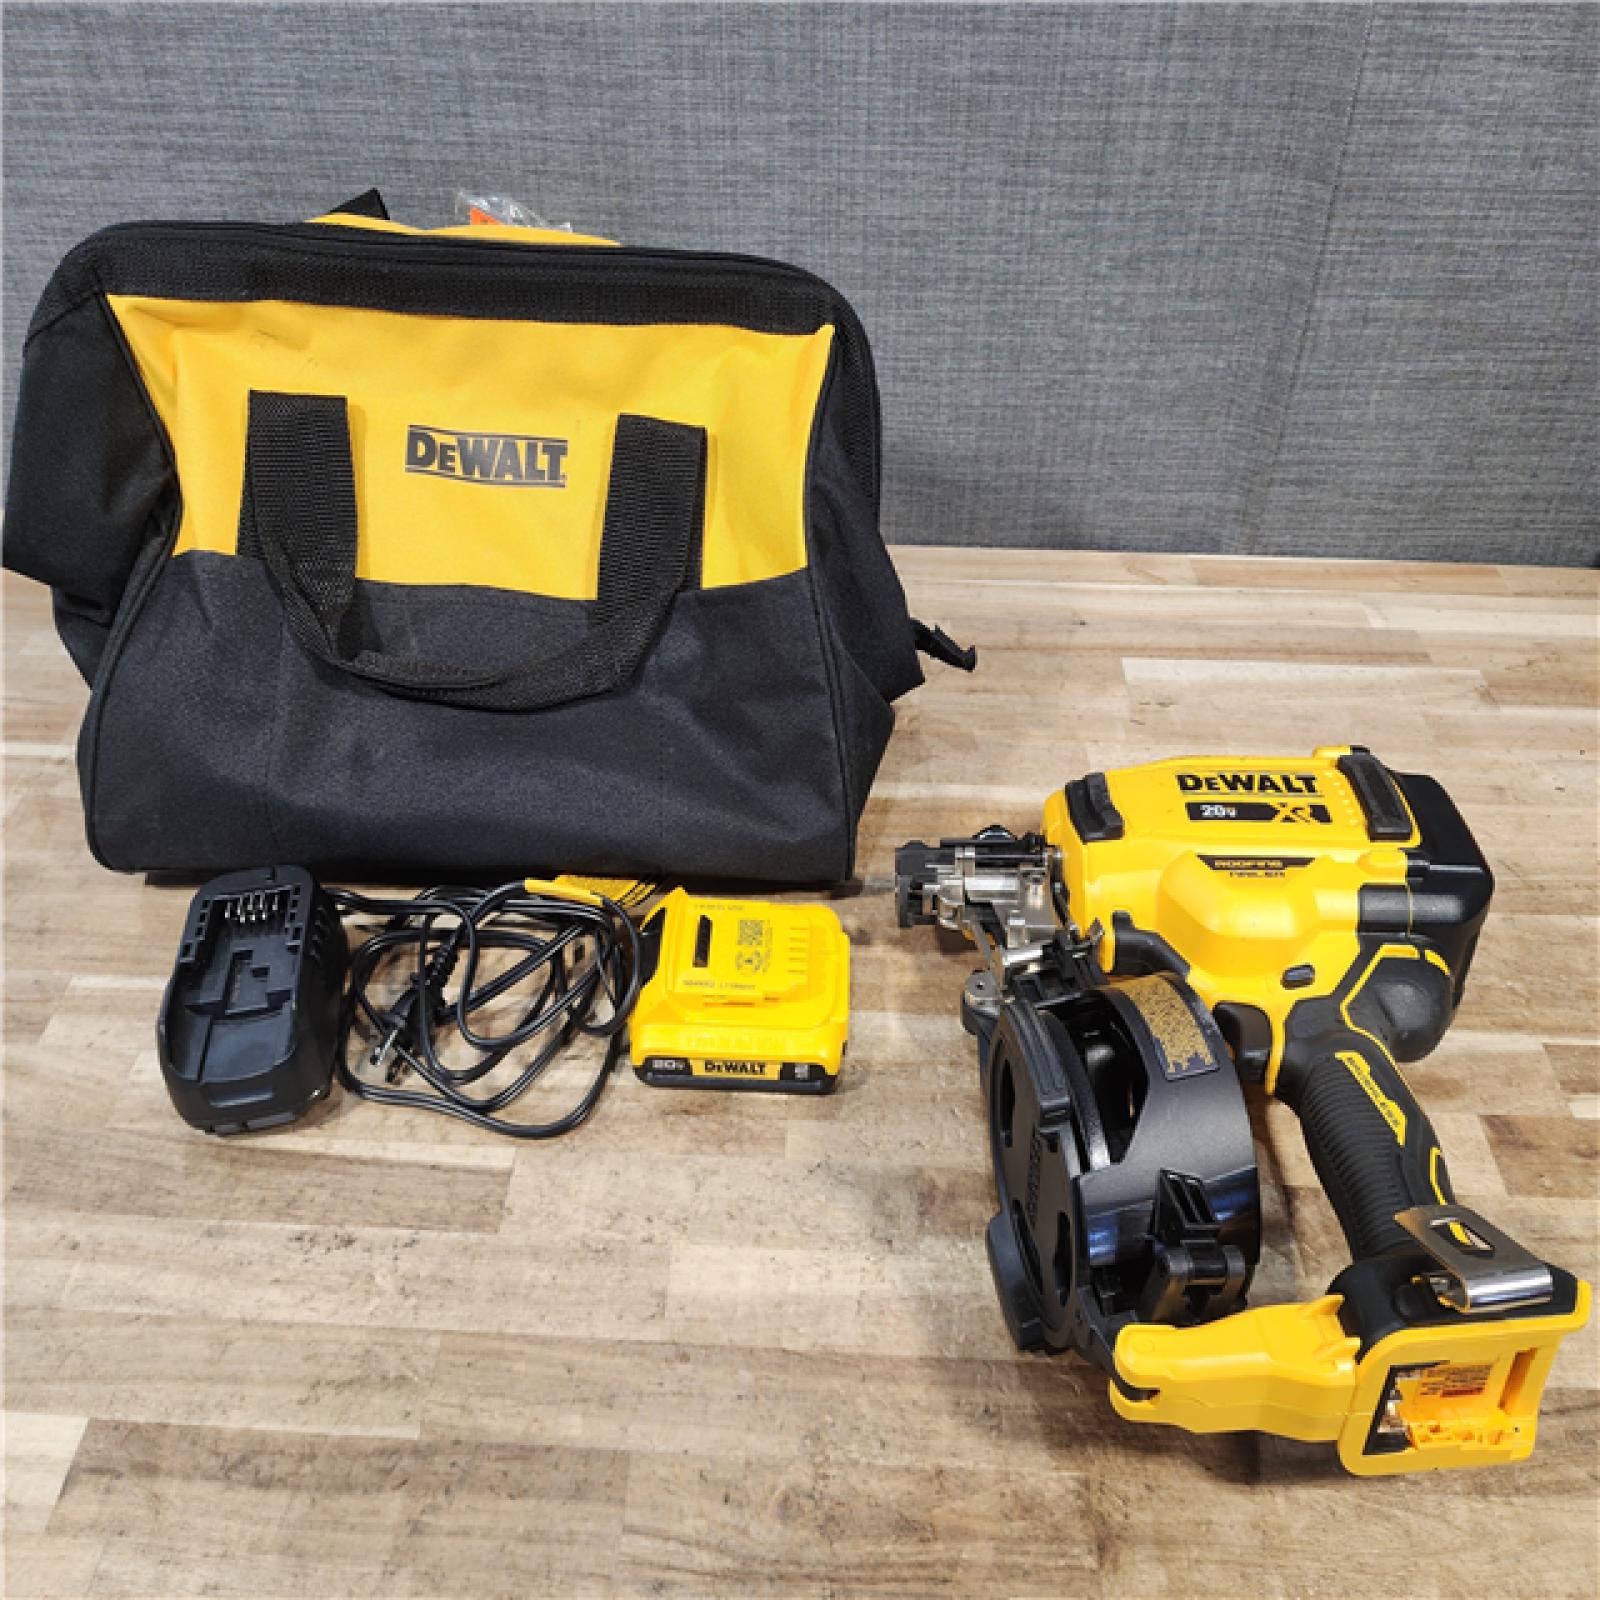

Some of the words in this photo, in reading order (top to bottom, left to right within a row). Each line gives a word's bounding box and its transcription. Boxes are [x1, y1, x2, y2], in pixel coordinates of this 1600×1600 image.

[406, 429, 568, 482] DEWALT
[1176, 774, 1318, 793] DEWALT
[704, 1059, 766, 1075] DEWALT
